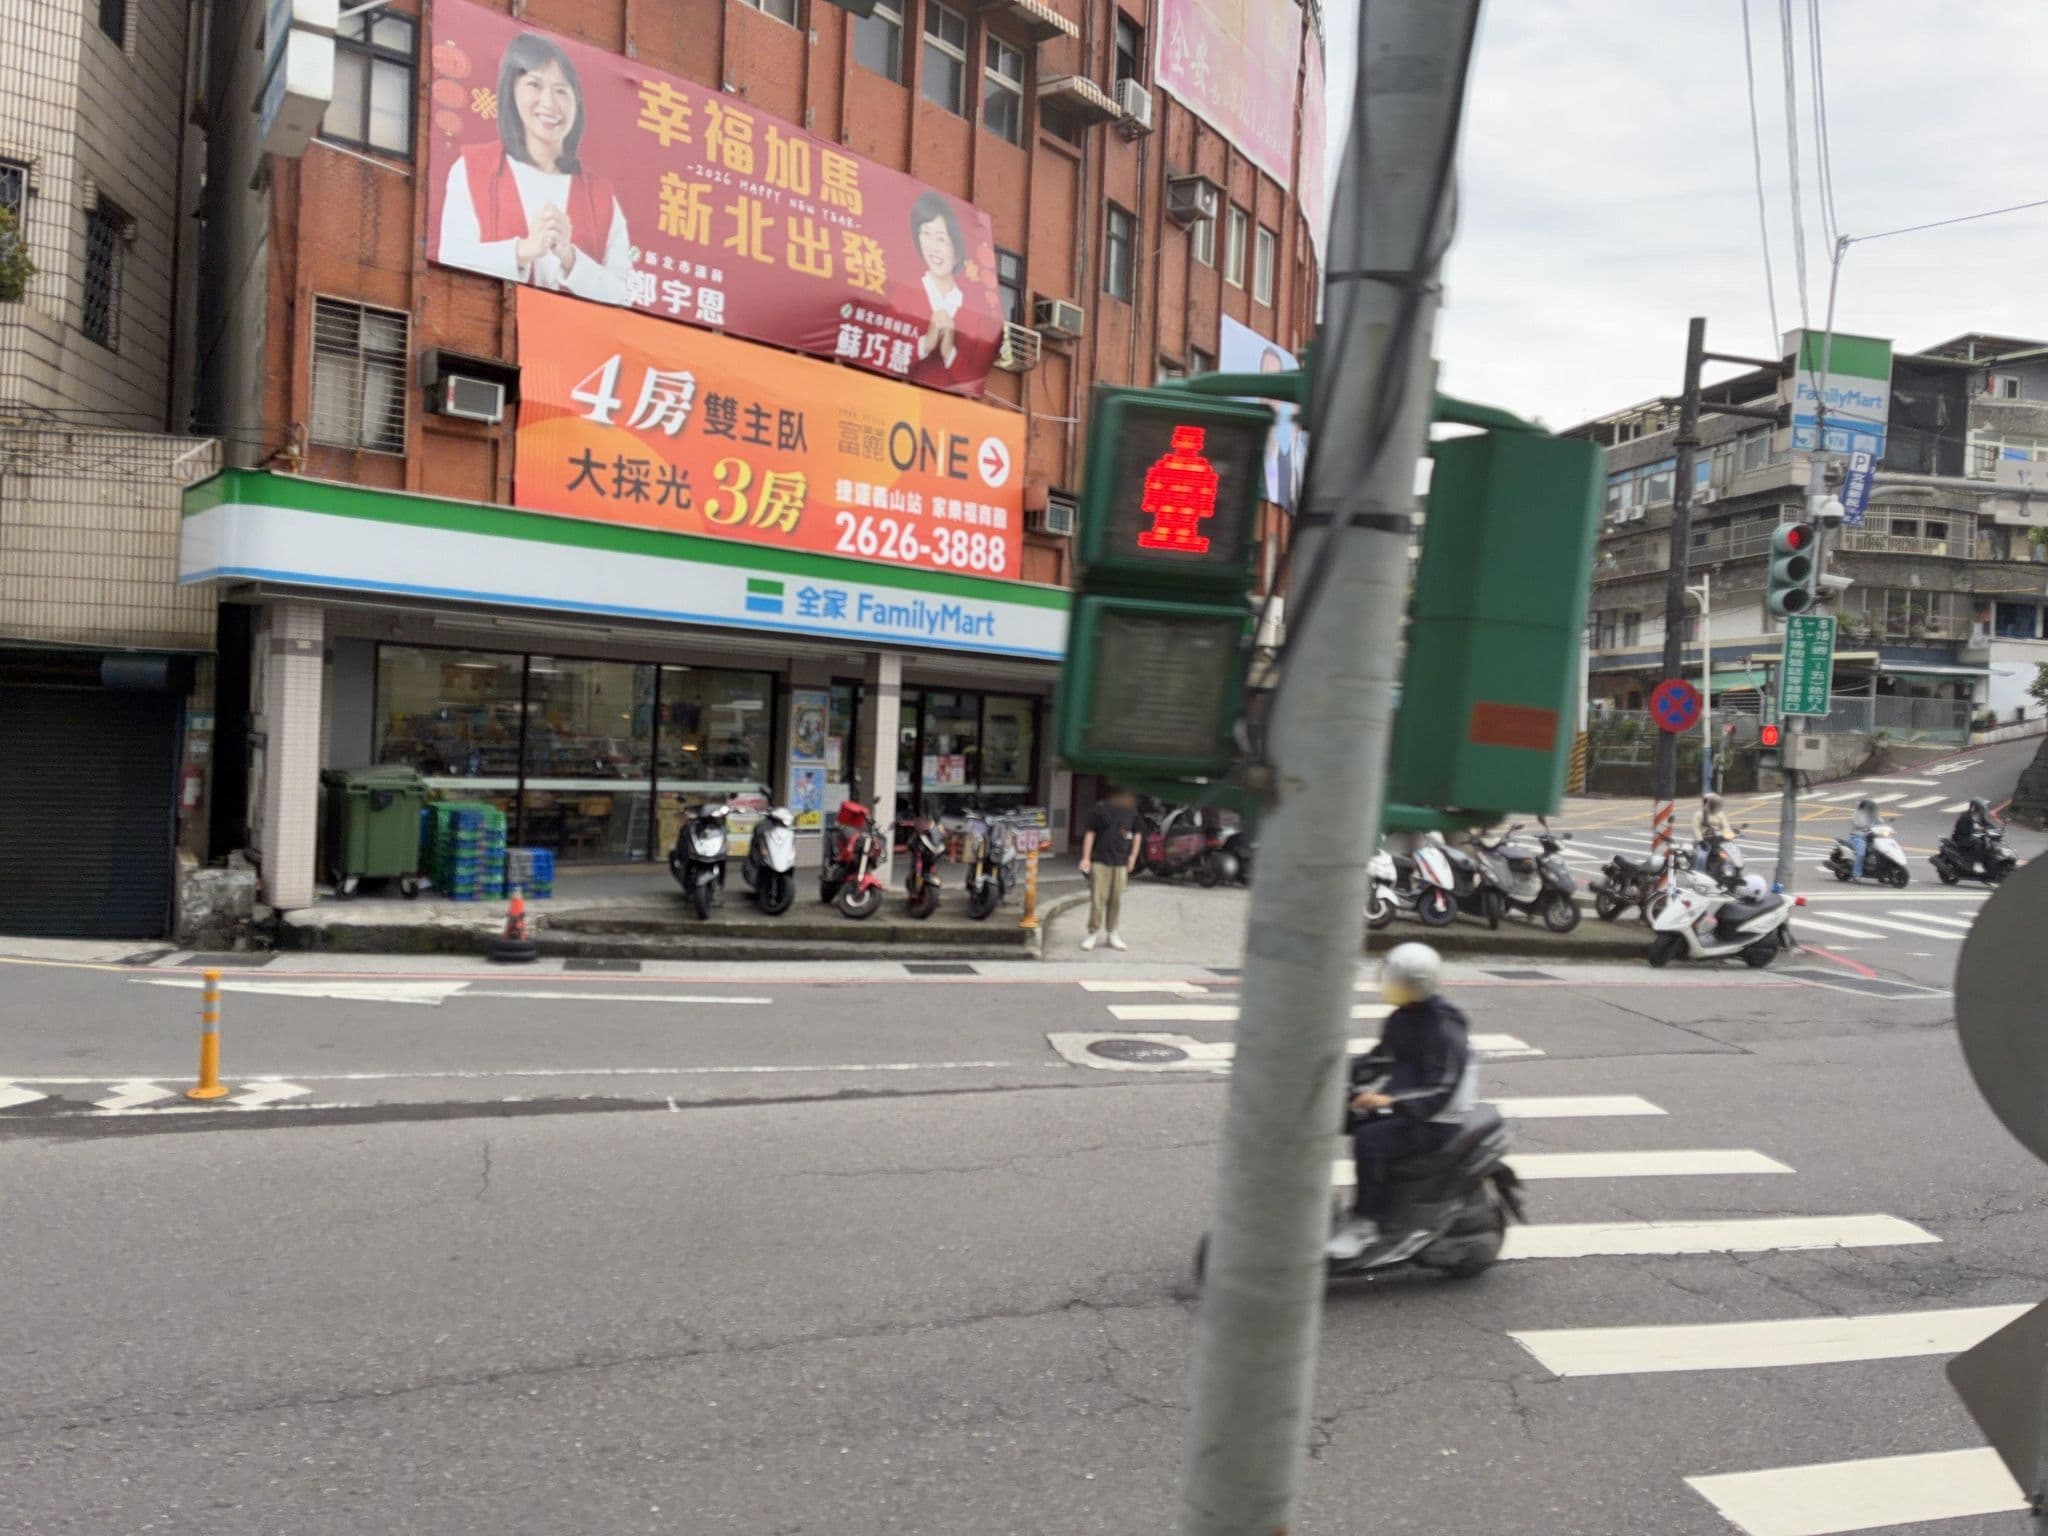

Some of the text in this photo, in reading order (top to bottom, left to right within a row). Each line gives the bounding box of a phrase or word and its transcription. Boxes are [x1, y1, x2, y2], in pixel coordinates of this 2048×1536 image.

[638, 79, 864, 217] 幸福加馬
[739, 179, 782, 205] HAPPY
[789, 198, 816, 215] NEW
[657, 171, 888, 297] 新北出發
[624, 269, 726, 326] 鄭宇恩
[834, 323, 914, 374] 蘇巧慧
[570, 352, 809, 454] 4房 雙主臥
[1796, 384, 1883, 409] FamilyMart
[566, 447, 808, 534] 大採光 3房
[1855, 455, 1866, 469] P
[834, 511, 1006, 573] 2626-3888
[796, 586, 996, 639] 全家 FamilyMart
